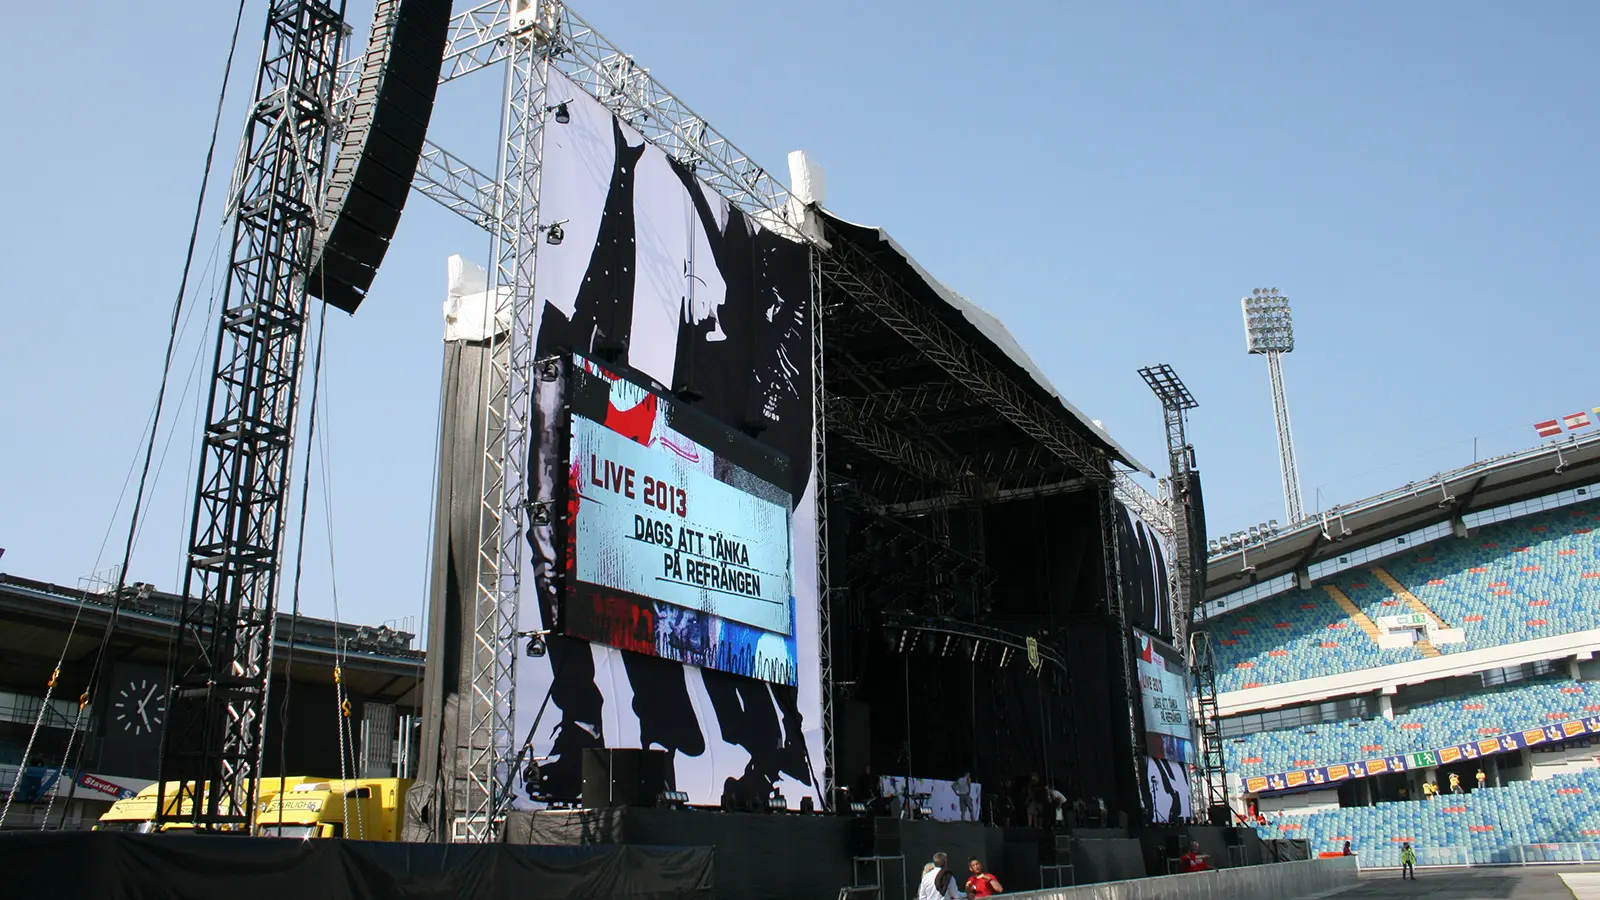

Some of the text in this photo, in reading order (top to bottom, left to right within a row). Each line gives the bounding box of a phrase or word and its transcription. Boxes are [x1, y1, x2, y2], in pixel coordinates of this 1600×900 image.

[591, 453, 687, 517] LIVE 2013
[634, 514, 749, 566] DAGS ATT TÄNKA
[664, 551, 761, 597] PÅ REFRÄNGEN
[84, 777, 118, 794] Stavdal
